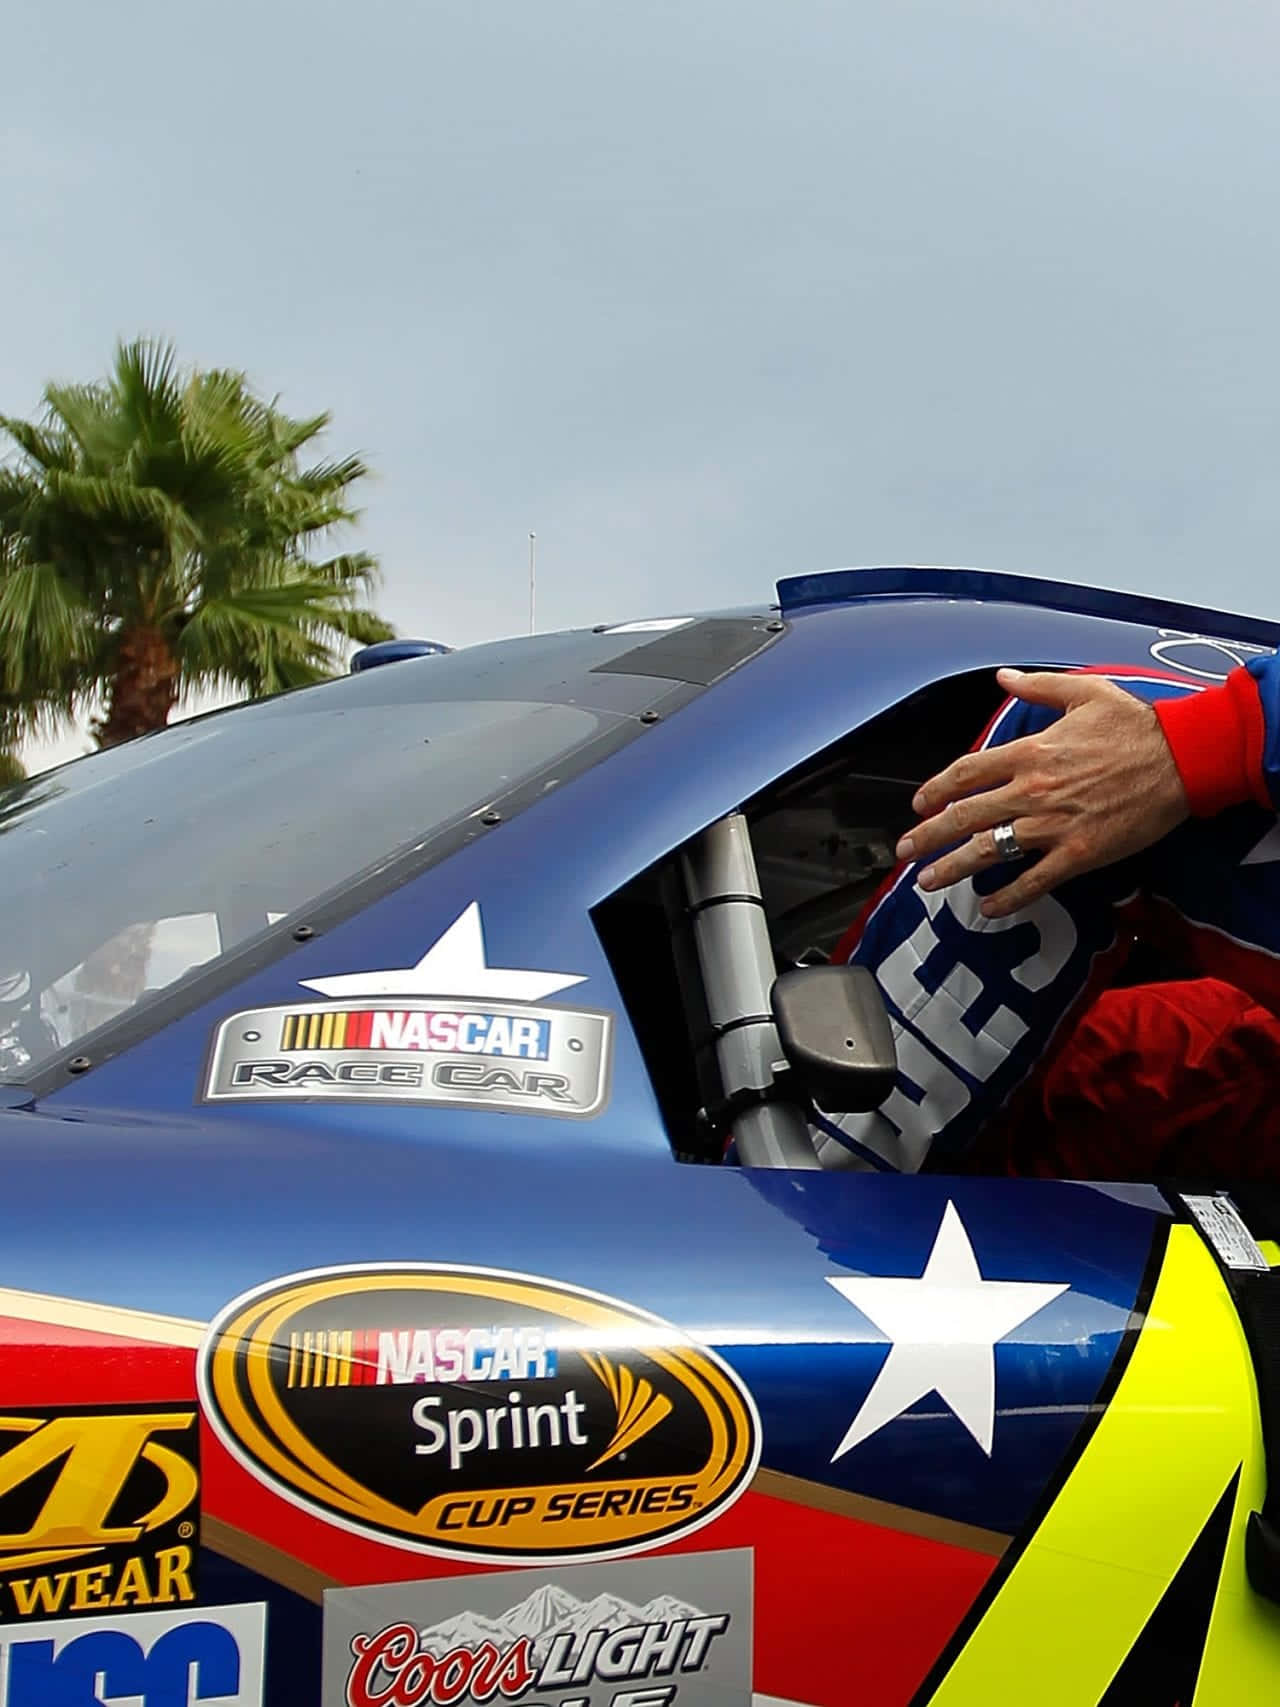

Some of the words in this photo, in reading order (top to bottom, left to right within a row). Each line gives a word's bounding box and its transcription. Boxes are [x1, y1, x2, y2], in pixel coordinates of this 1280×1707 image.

[370, 1011, 540, 1058] NASCAR
[231, 1060, 424, 1088] RACE
[433, 1061, 578, 1105] CAR
[375, 1328, 553, 1384] NASCAR
[411, 1390, 589, 1470] Sprint
[435, 1498, 535, 1531] CUP
[540, 1483, 700, 1523] SERIES
[9, 1545, 195, 1616] WEAR
[347, 1624, 537, 1707] Coors
[538, 1613, 730, 1692] LIGHT
